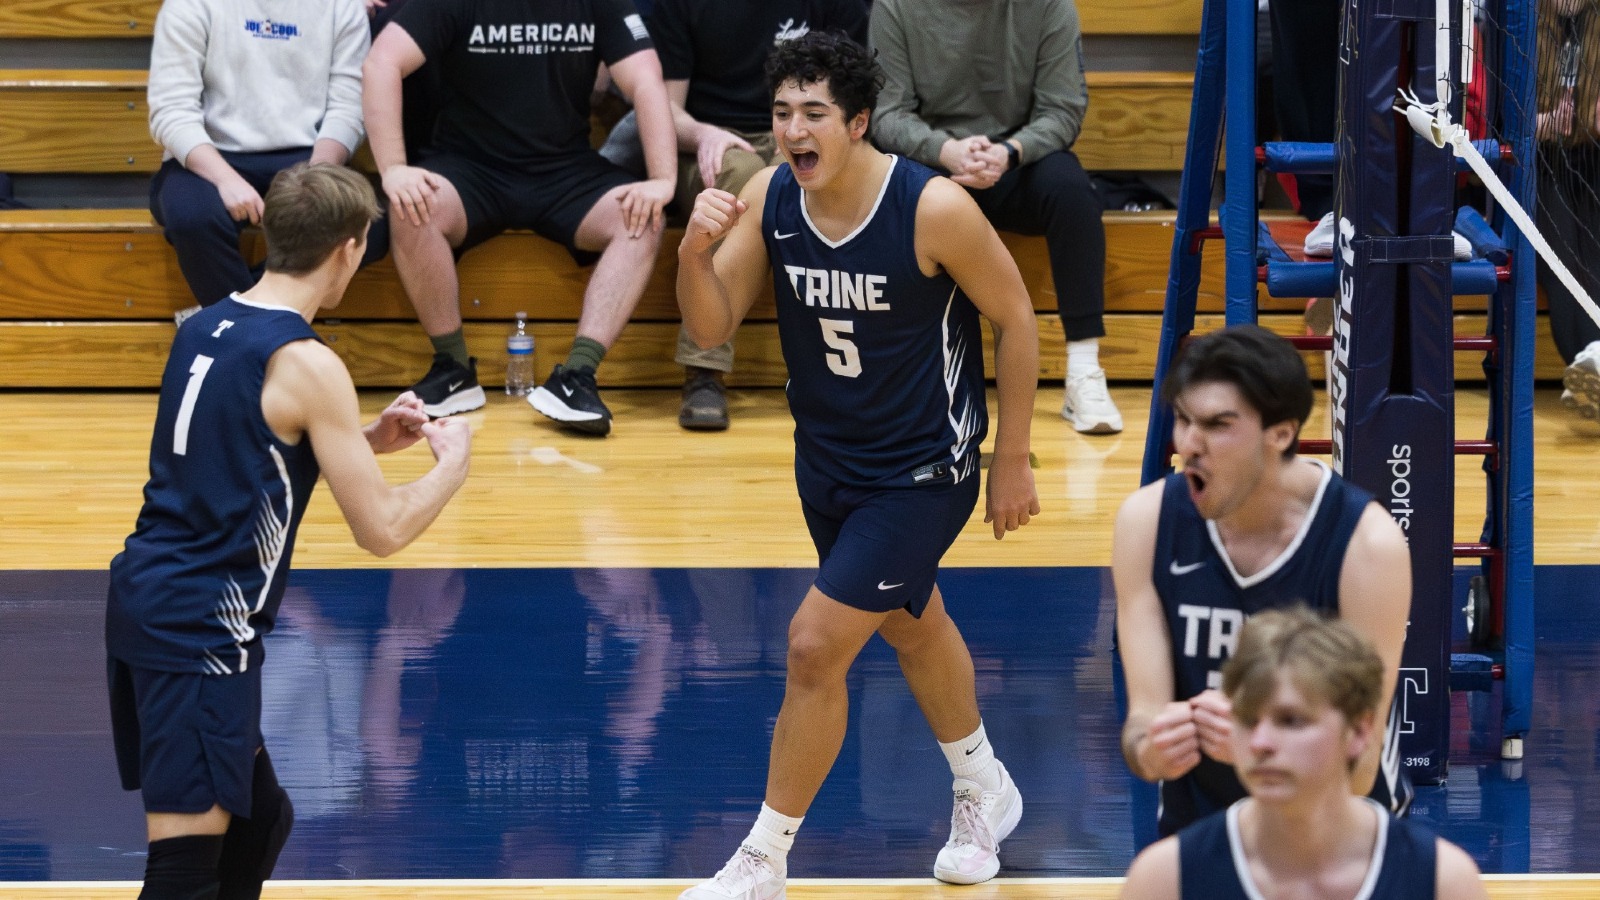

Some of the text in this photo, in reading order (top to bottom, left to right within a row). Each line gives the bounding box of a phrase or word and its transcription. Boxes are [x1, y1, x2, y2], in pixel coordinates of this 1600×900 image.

[469, 23, 595, 45] AMERICAN
[784, 264, 891, 311] TRINE
[818, 317, 863, 378] 5
[173, 353, 215, 456] 1
[1387, 444, 1414, 530] sports
[1178, 604, 1247, 659] TR
